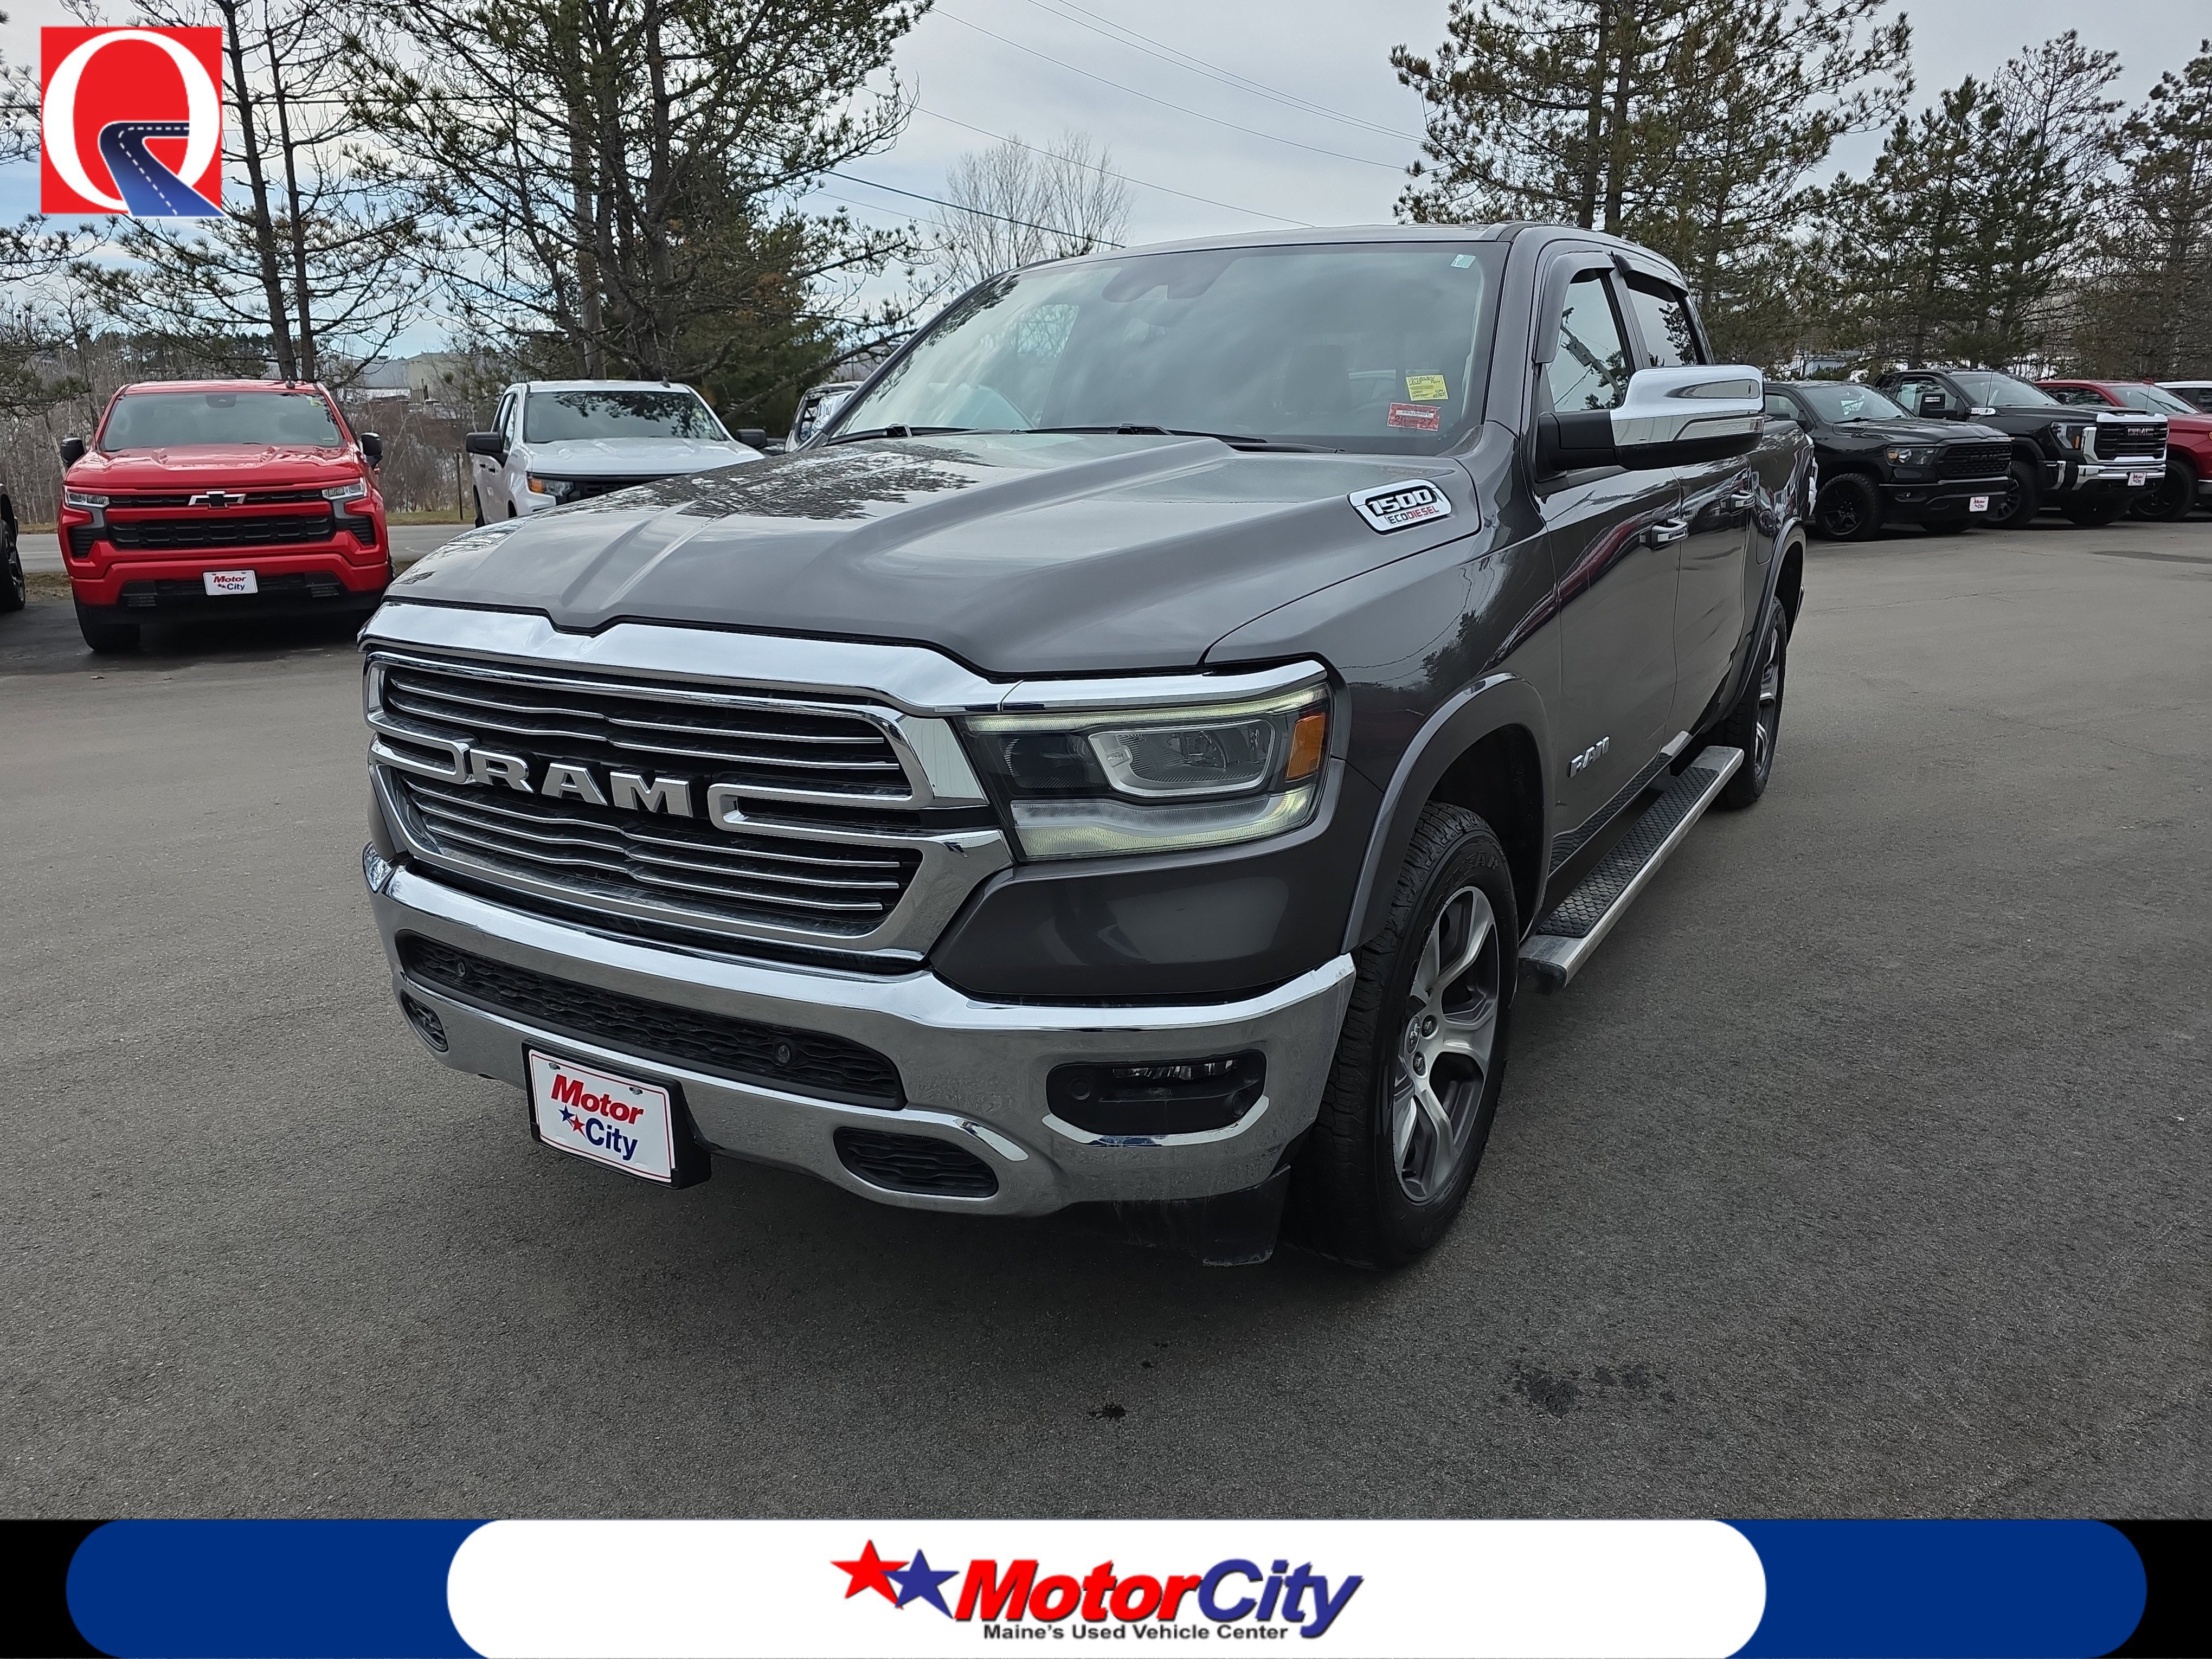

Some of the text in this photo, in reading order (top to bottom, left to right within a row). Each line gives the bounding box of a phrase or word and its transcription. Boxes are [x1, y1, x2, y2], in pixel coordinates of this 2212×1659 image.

[2128, 428, 2154, 436] GMC
[1368, 488, 1433, 515] 1500
[1387, 504, 1440, 524] ECODIESEL
[227, 583, 246, 591] City
[1570, 736, 1610, 777] RAM
[470, 748, 693, 818] RAM
[551, 1073, 644, 1125] Motor
[585, 1117, 638, 1161] City
